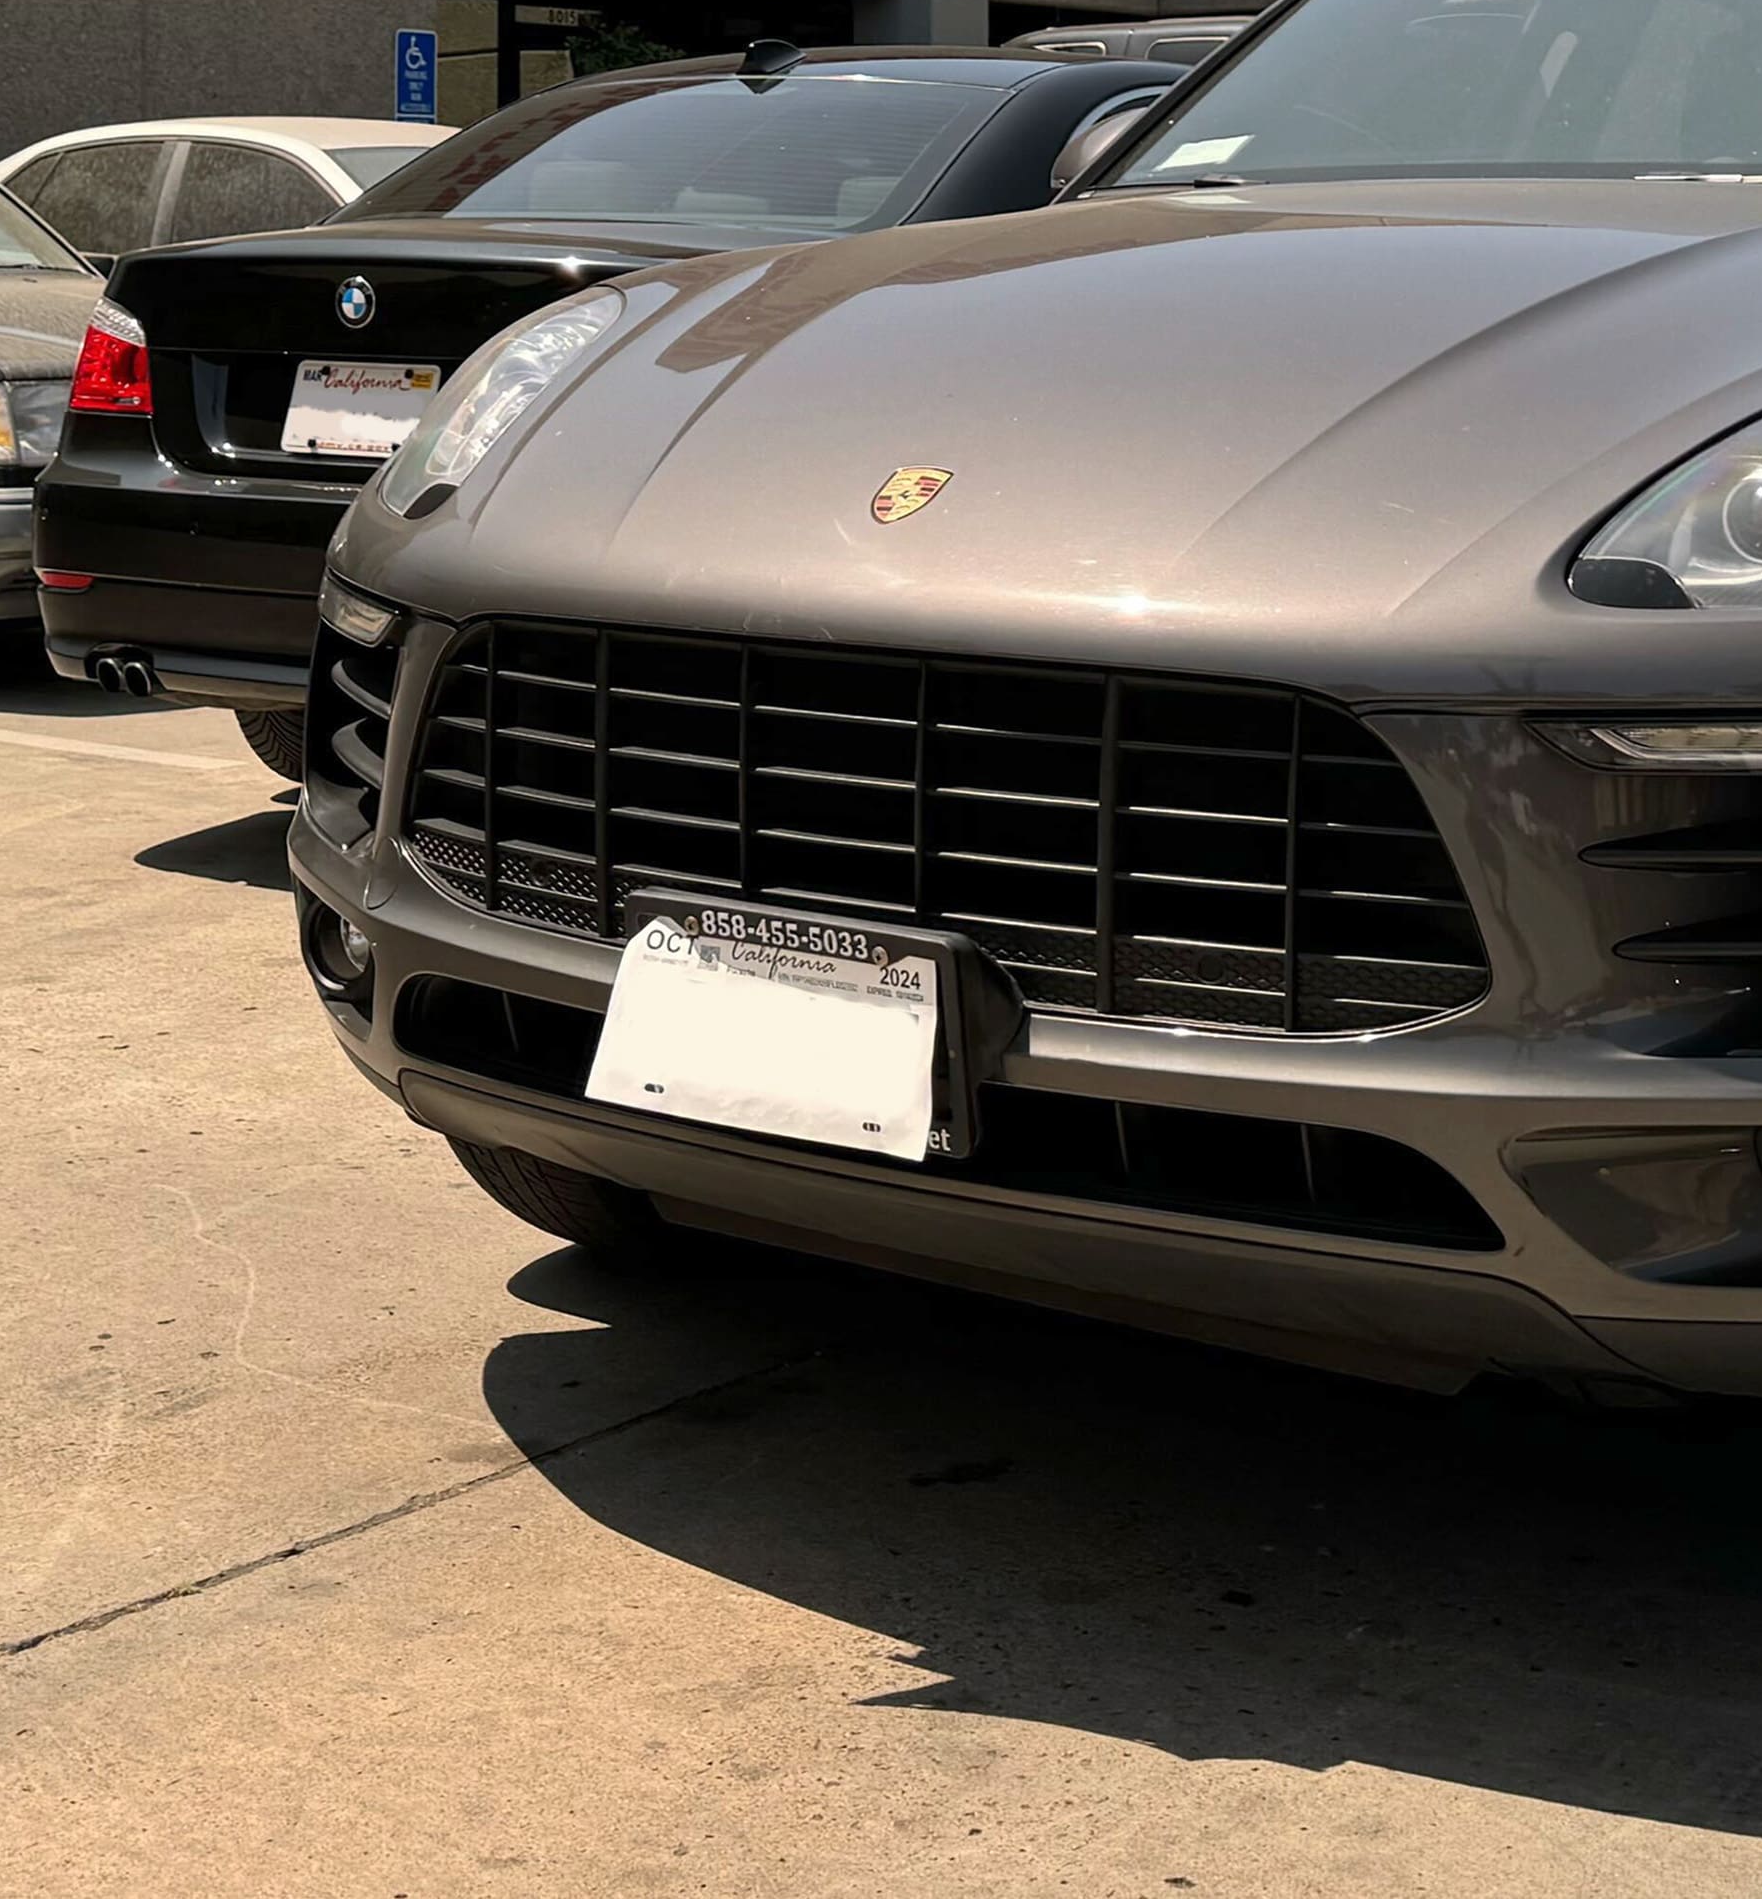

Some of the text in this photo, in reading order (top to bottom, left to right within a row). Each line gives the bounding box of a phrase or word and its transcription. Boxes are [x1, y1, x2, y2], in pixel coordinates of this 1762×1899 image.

[324, 367, 411, 395] California
[701, 910, 869, 959] 858-455-5033
[731, 940, 838, 981] California
[879, 965, 922, 991] 2024
